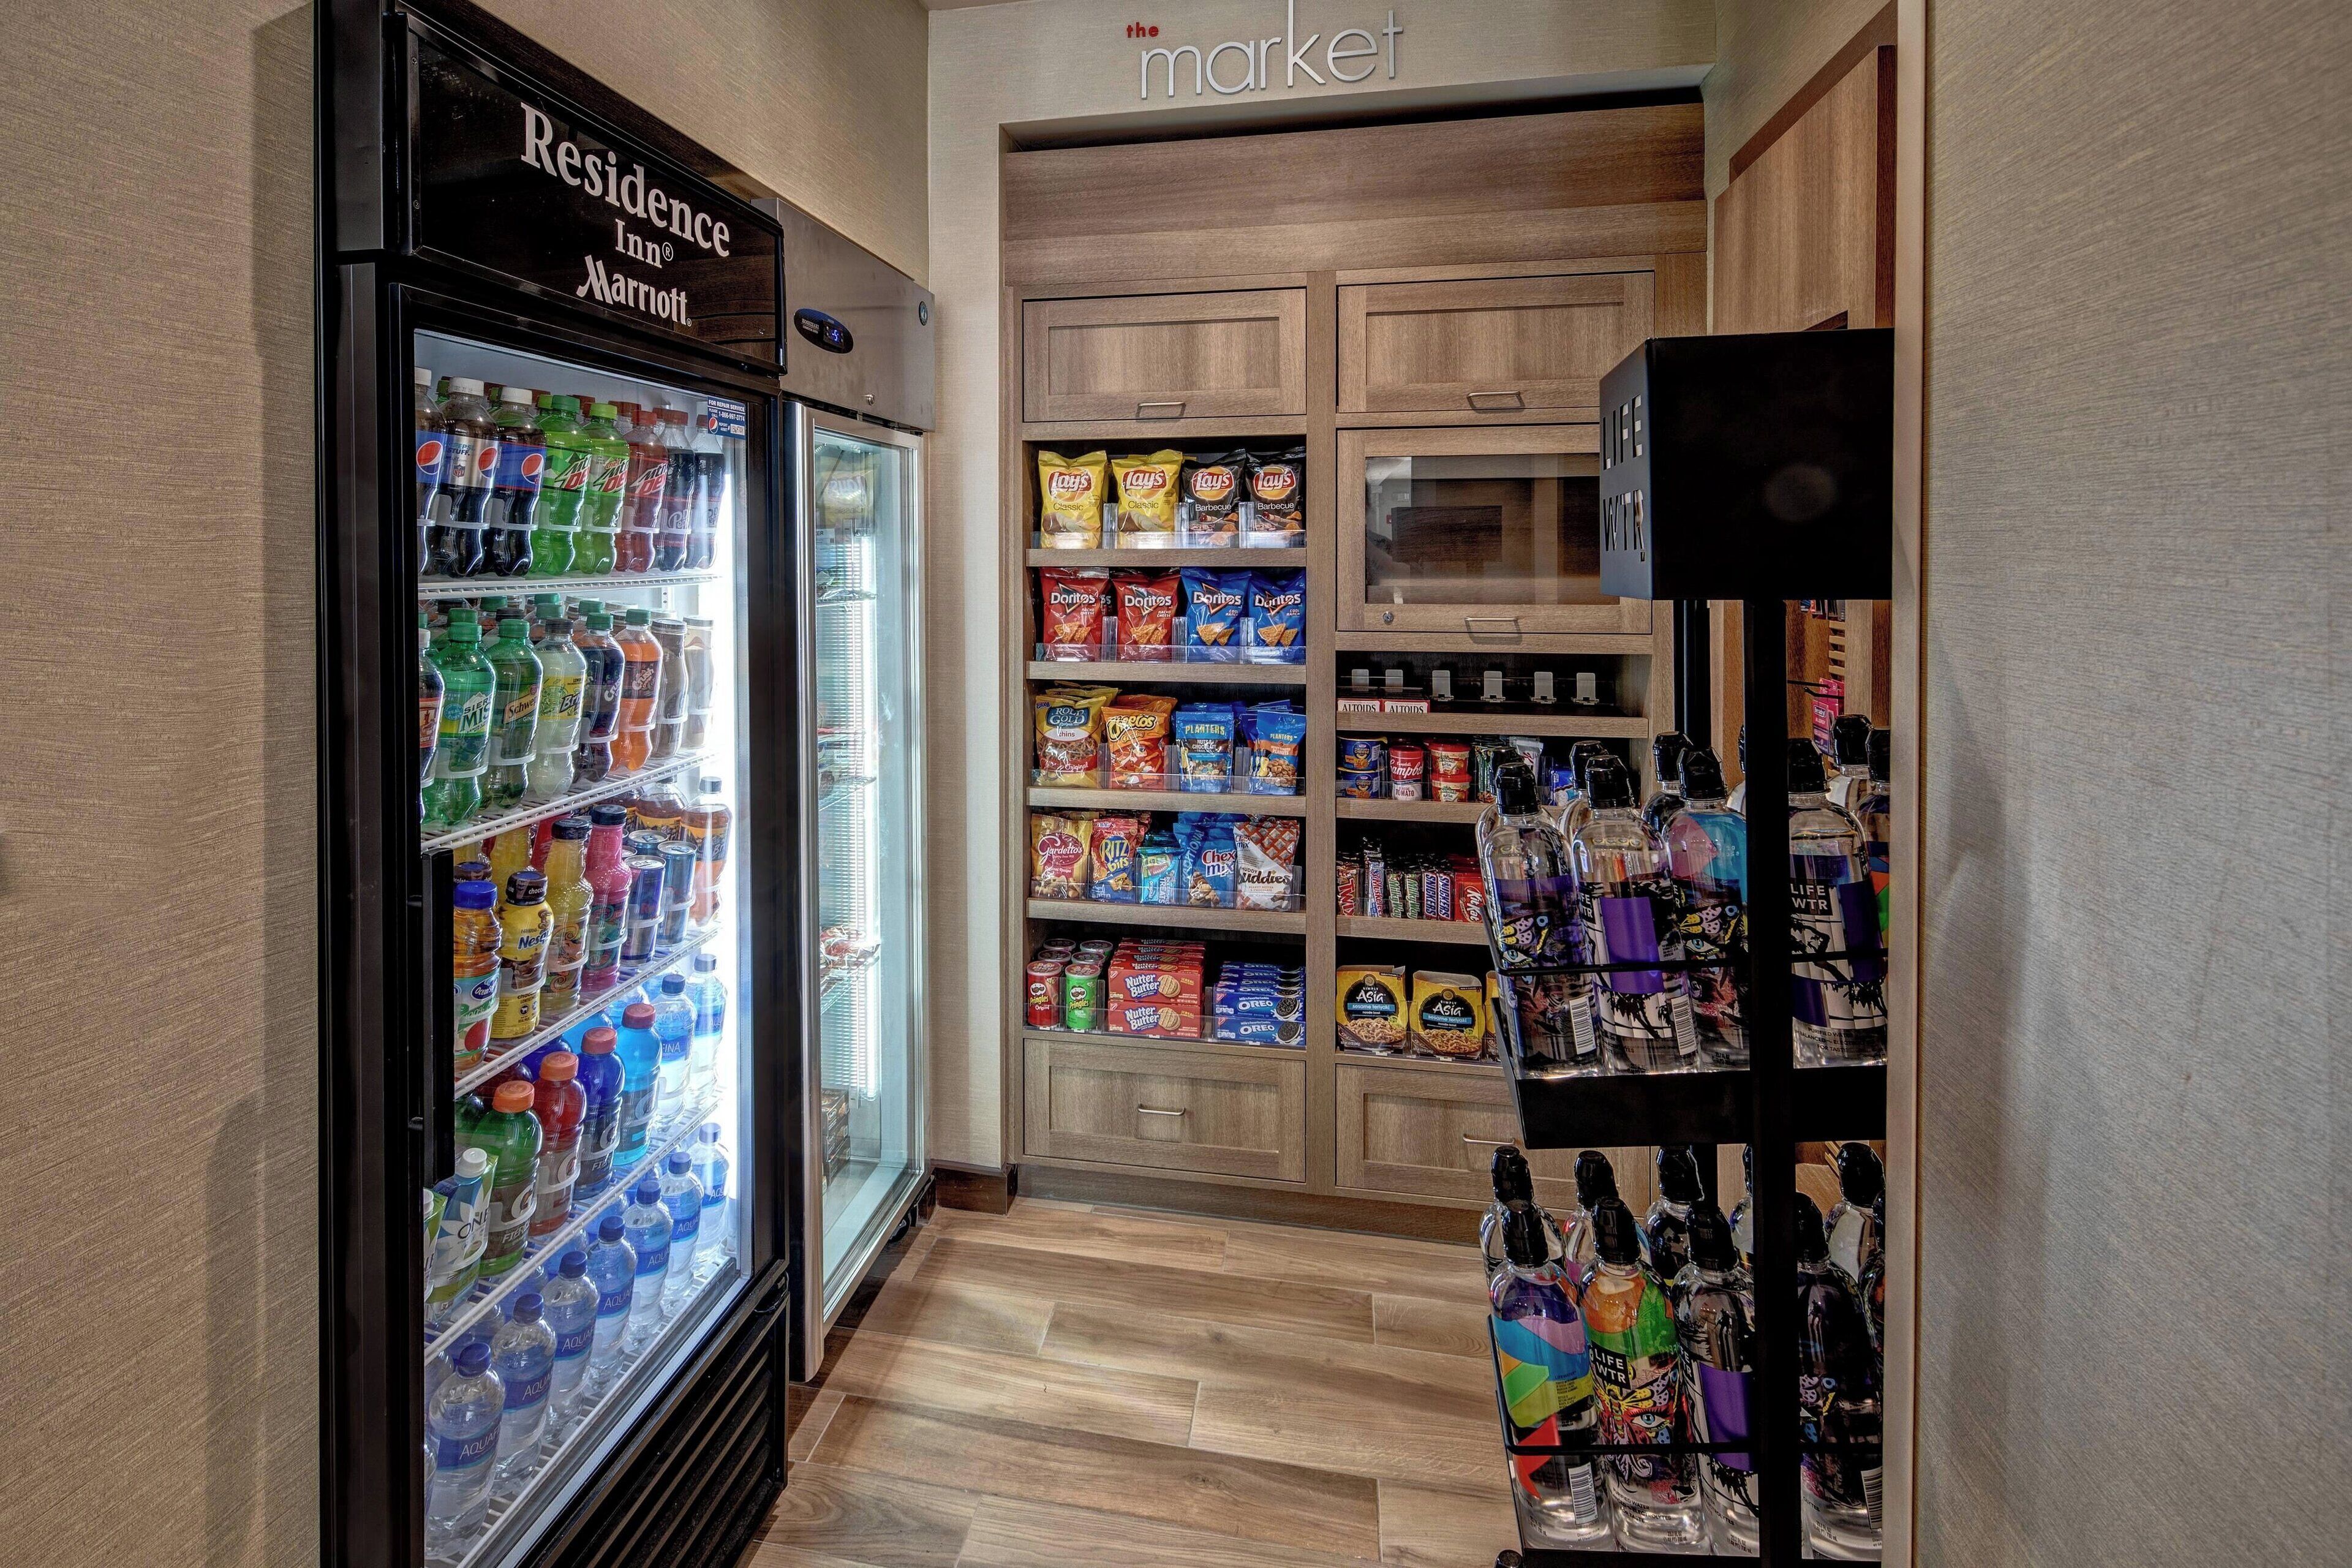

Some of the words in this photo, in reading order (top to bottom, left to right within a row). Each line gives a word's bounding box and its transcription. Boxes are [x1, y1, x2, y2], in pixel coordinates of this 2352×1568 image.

[1126, 22, 1159, 38] the
[1141, 0, 1403, 100] market
[521, 102, 729, 257] Residence
[1603, 394, 1643, 470] LIFE
[564, 466, 590, 489] DE
[602, 470, 628, 492] DE
[640, 473, 666, 494] DE
[1050, 472, 1091, 492] Lay's
[1125, 470, 1164, 490] Lay's
[1195, 472, 1231, 491] Lay's
[1257, 472, 1292, 491] Lay's
[1195, 503, 1232, 511] Barbecue
[1603, 489, 1644, 552] WTR
[1050, 592, 1096, 605] Doritos
[1125, 595, 1172, 608] Doritos
[1193, 592, 1242, 606] Doritos
[1255, 593, 1301, 608] Doritos
[464, 695, 492, 714] SIER
[508, 696, 537, 718] Schwe
[1055, 707, 1084, 716] ROLD
[461, 703, 491, 731] MIS
[1049, 715, 1085, 724] GOLD
[1185, 724, 1225, 735] PLANTERS
[1065, 762, 1088, 772] Original
[1038, 835, 1083, 865] Gardetto's
[1101, 839, 1129, 862] RITZ
[1202, 849, 1237, 864] Chex
[1107, 858, 1129, 872] bits
[1206, 862, 1235, 877] mix
[1338, 878, 1355, 916] TWIX
[1425, 873, 1437, 917] SNICKERS
[1439, 875, 1450, 919] SNICKERS
[1790, 883, 1826, 896] LIFE
[1792, 897, 1828, 910] WTR
[1125, 974, 1156, 989] Nutter
[1129, 981, 1159, 998] Butter
[1030, 995, 1049, 1006] Pringles
[1357, 989, 1386, 1003] Asia
[1069, 998, 1089, 1011] Pringles
[1238, 1000, 1273, 1011] OREO
[1433, 1003, 1464, 1017] Asia
[1125, 1006, 1156, 1021] Nutter
[1129, 1014, 1159, 1031] Butter
[1240, 1025, 1275, 1035] OREO
[1594, 1349, 1624, 1370] LIFE
[1596, 1362, 1627, 1384] WTR
